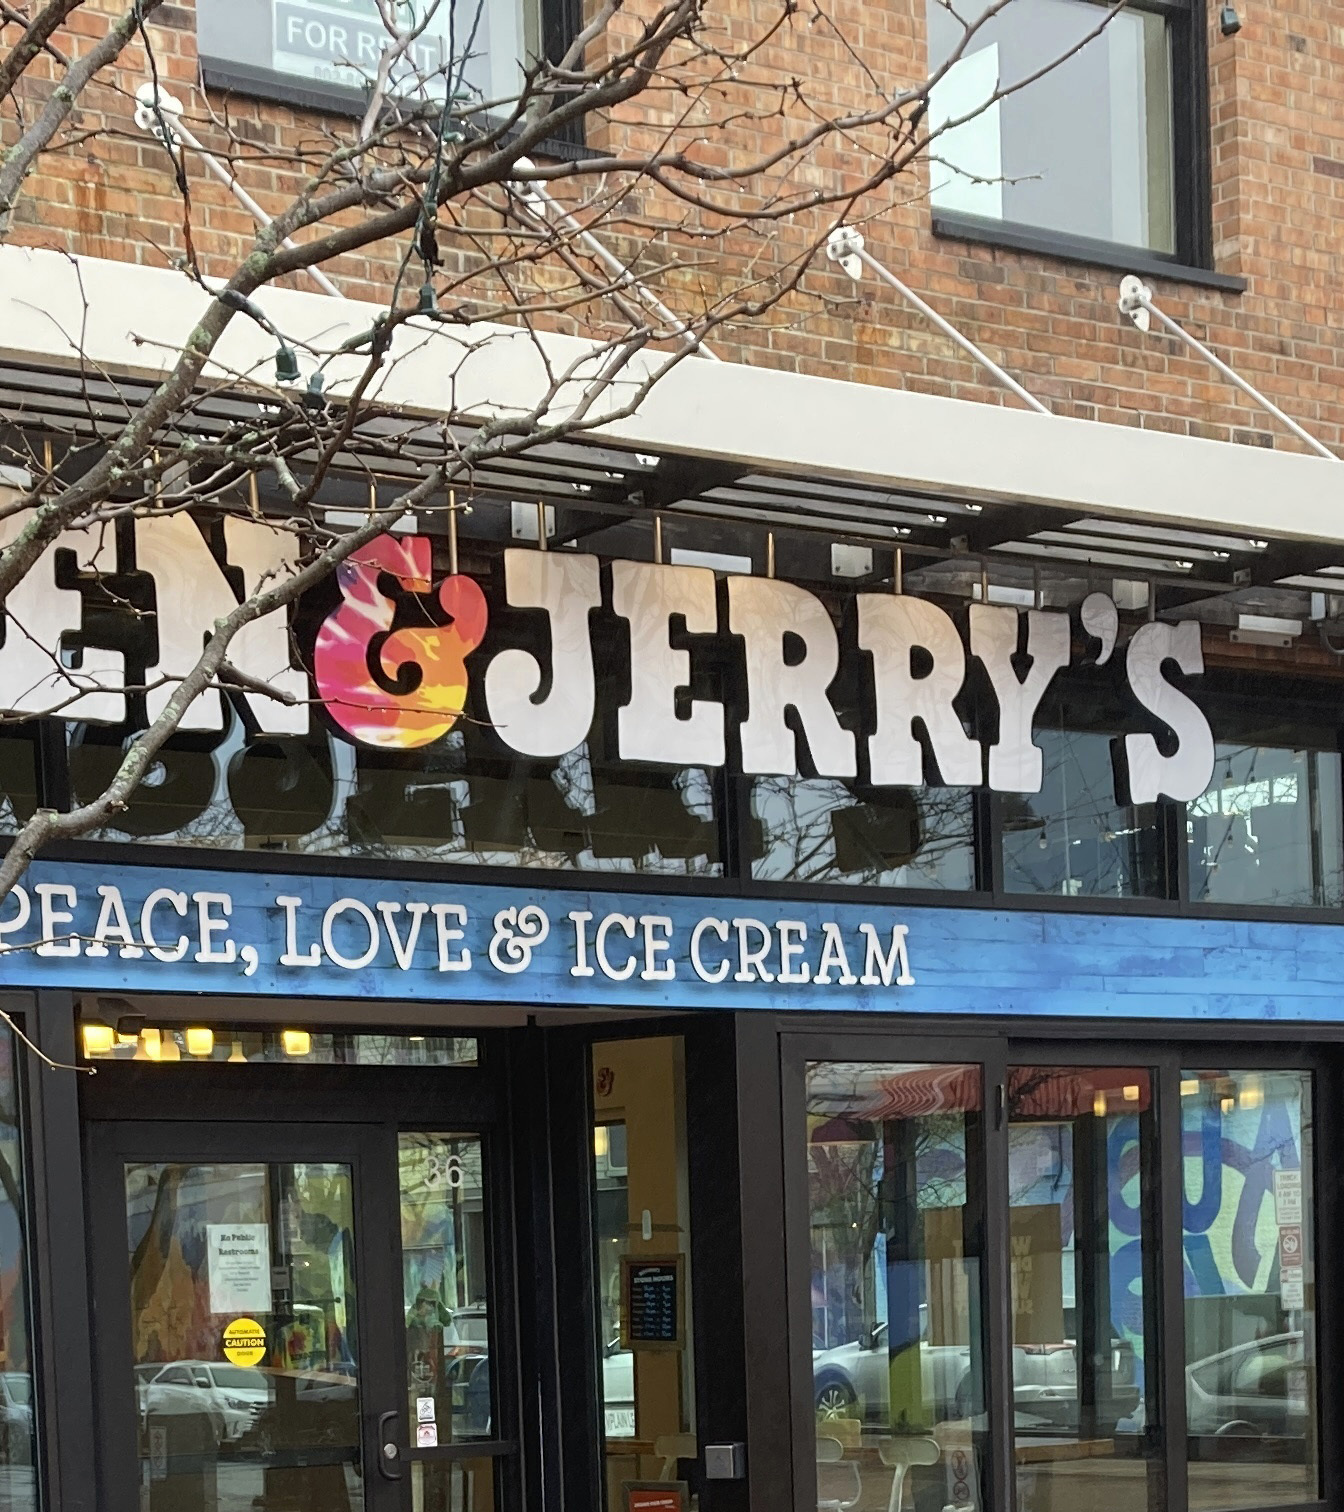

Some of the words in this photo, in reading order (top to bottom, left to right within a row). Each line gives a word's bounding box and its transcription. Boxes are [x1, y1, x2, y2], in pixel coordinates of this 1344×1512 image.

[287, 15, 348, 55] FOR
[314, 533, 488, 748] &
[485, 548, 1216, 804] JERRY'S
[276, 895, 472, 973] LOVE
[489, 905, 548, 974] &
[569, 910, 676, 982] ICE
[690, 917, 916, 988] CREAM
[423, 1155, 465, 1188] 36
[218, 1248, 259, 1256] Restrooms
[221, 1234, 231, 1242] No
[225, 1338, 264, 1347] CAUTION
